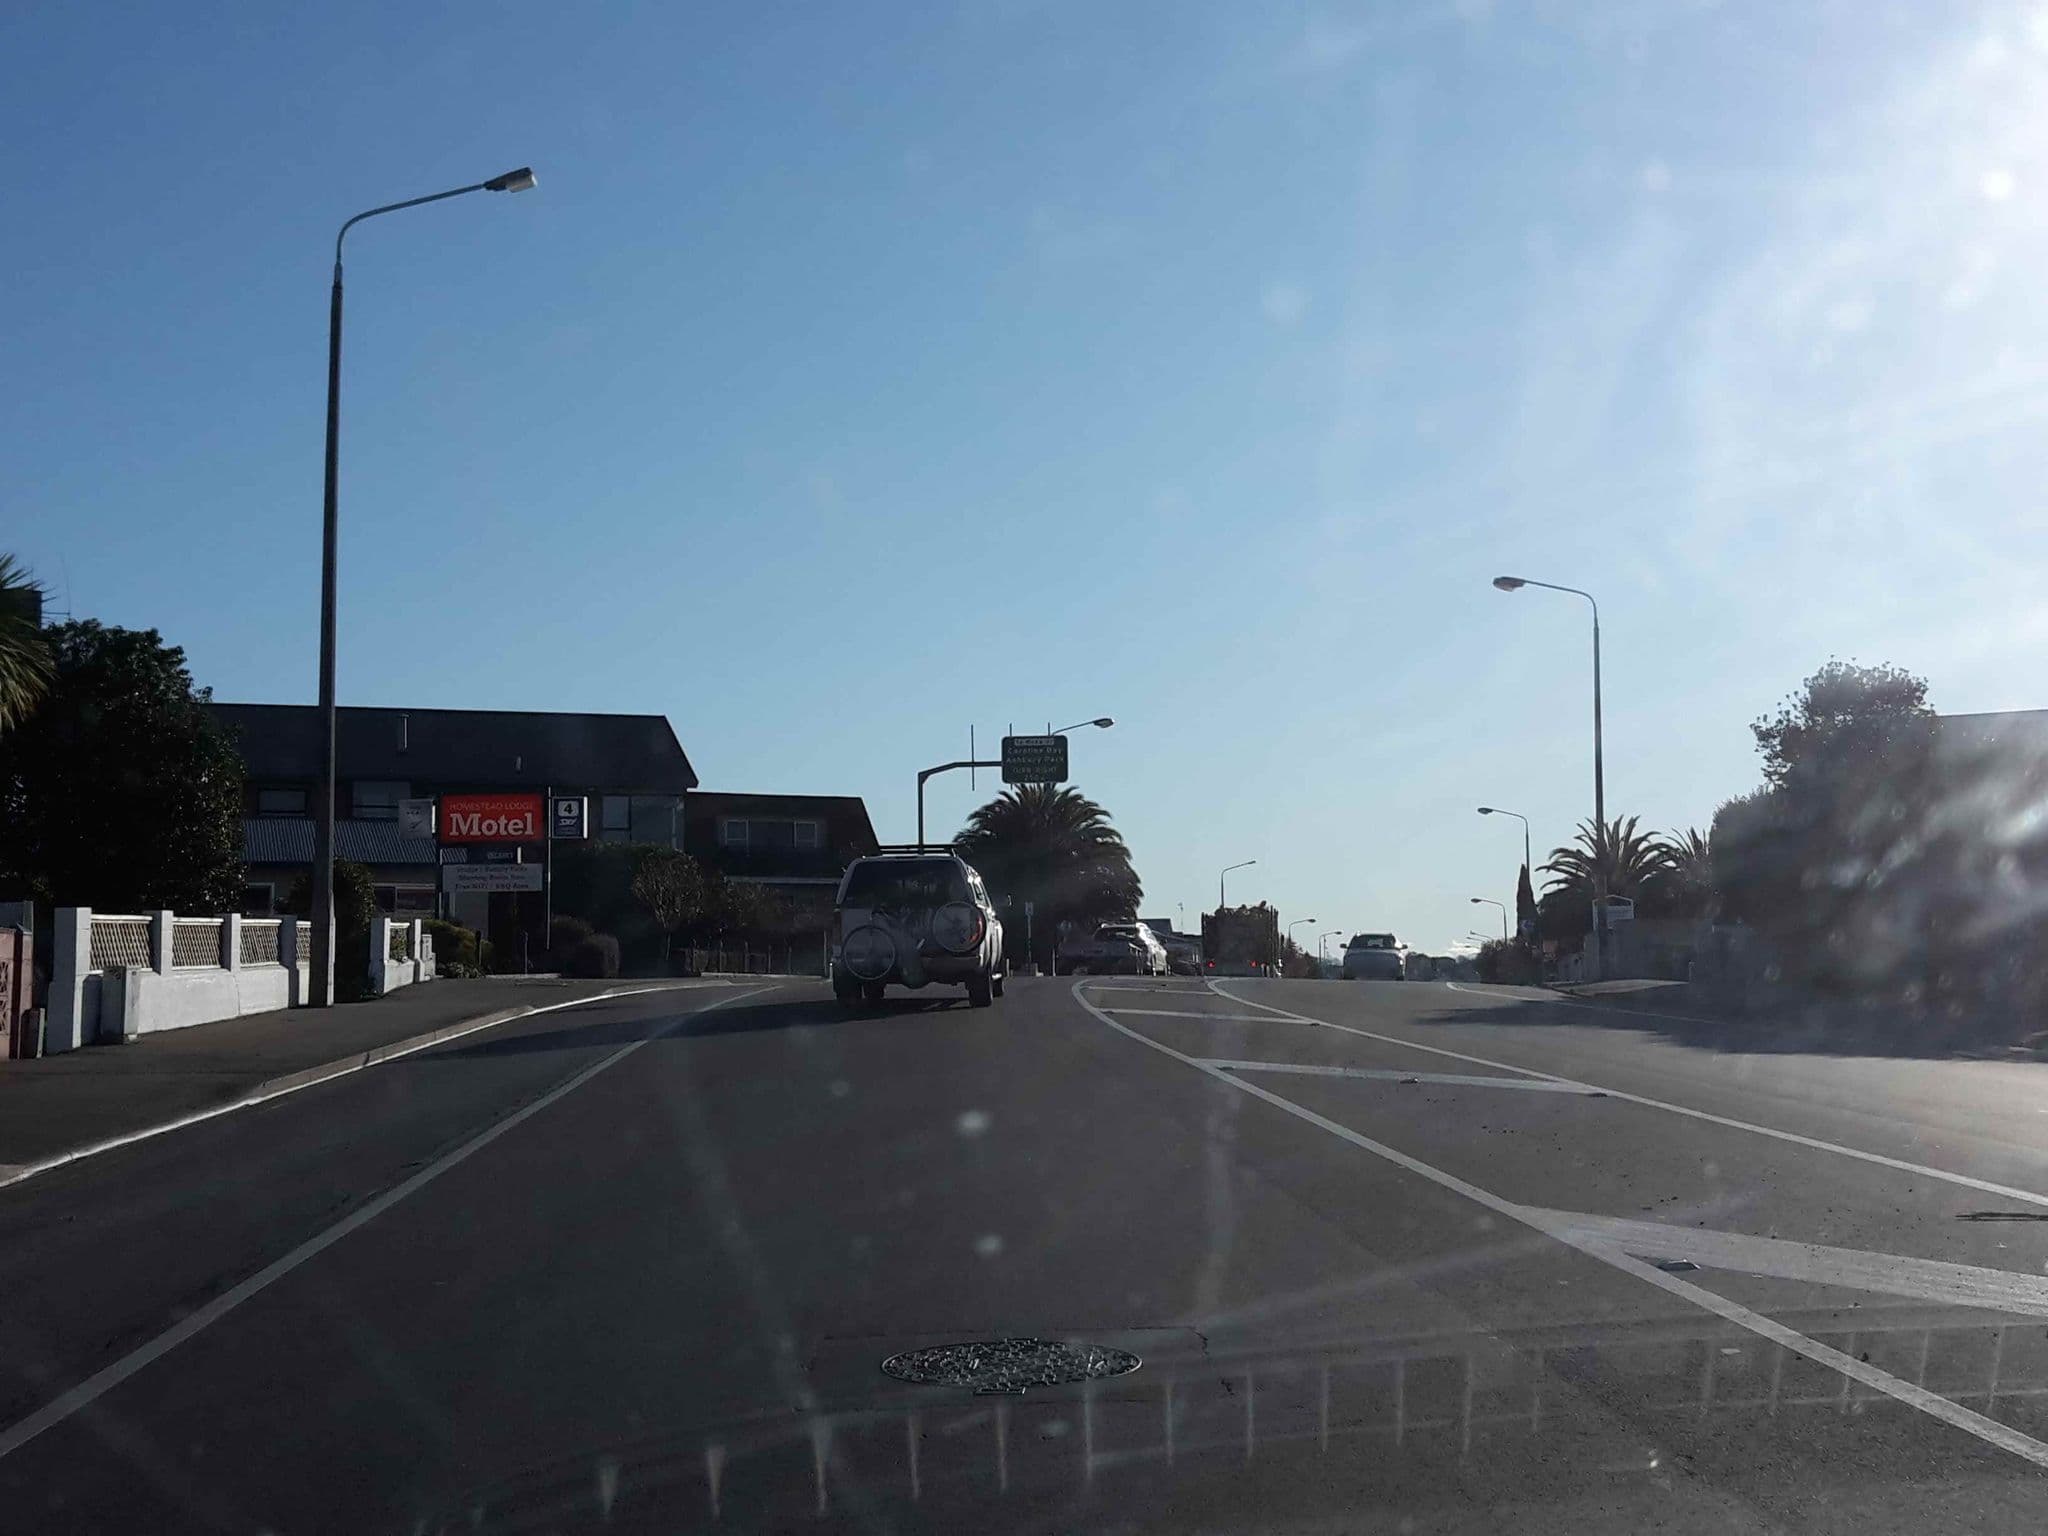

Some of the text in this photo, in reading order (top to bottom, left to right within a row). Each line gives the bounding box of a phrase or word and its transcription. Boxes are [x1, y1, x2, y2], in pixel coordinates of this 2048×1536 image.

[449, 799, 533, 811] HOMESTEAD LODGE
[563, 803, 574, 814] 4
[449, 812, 534, 836] Motel
